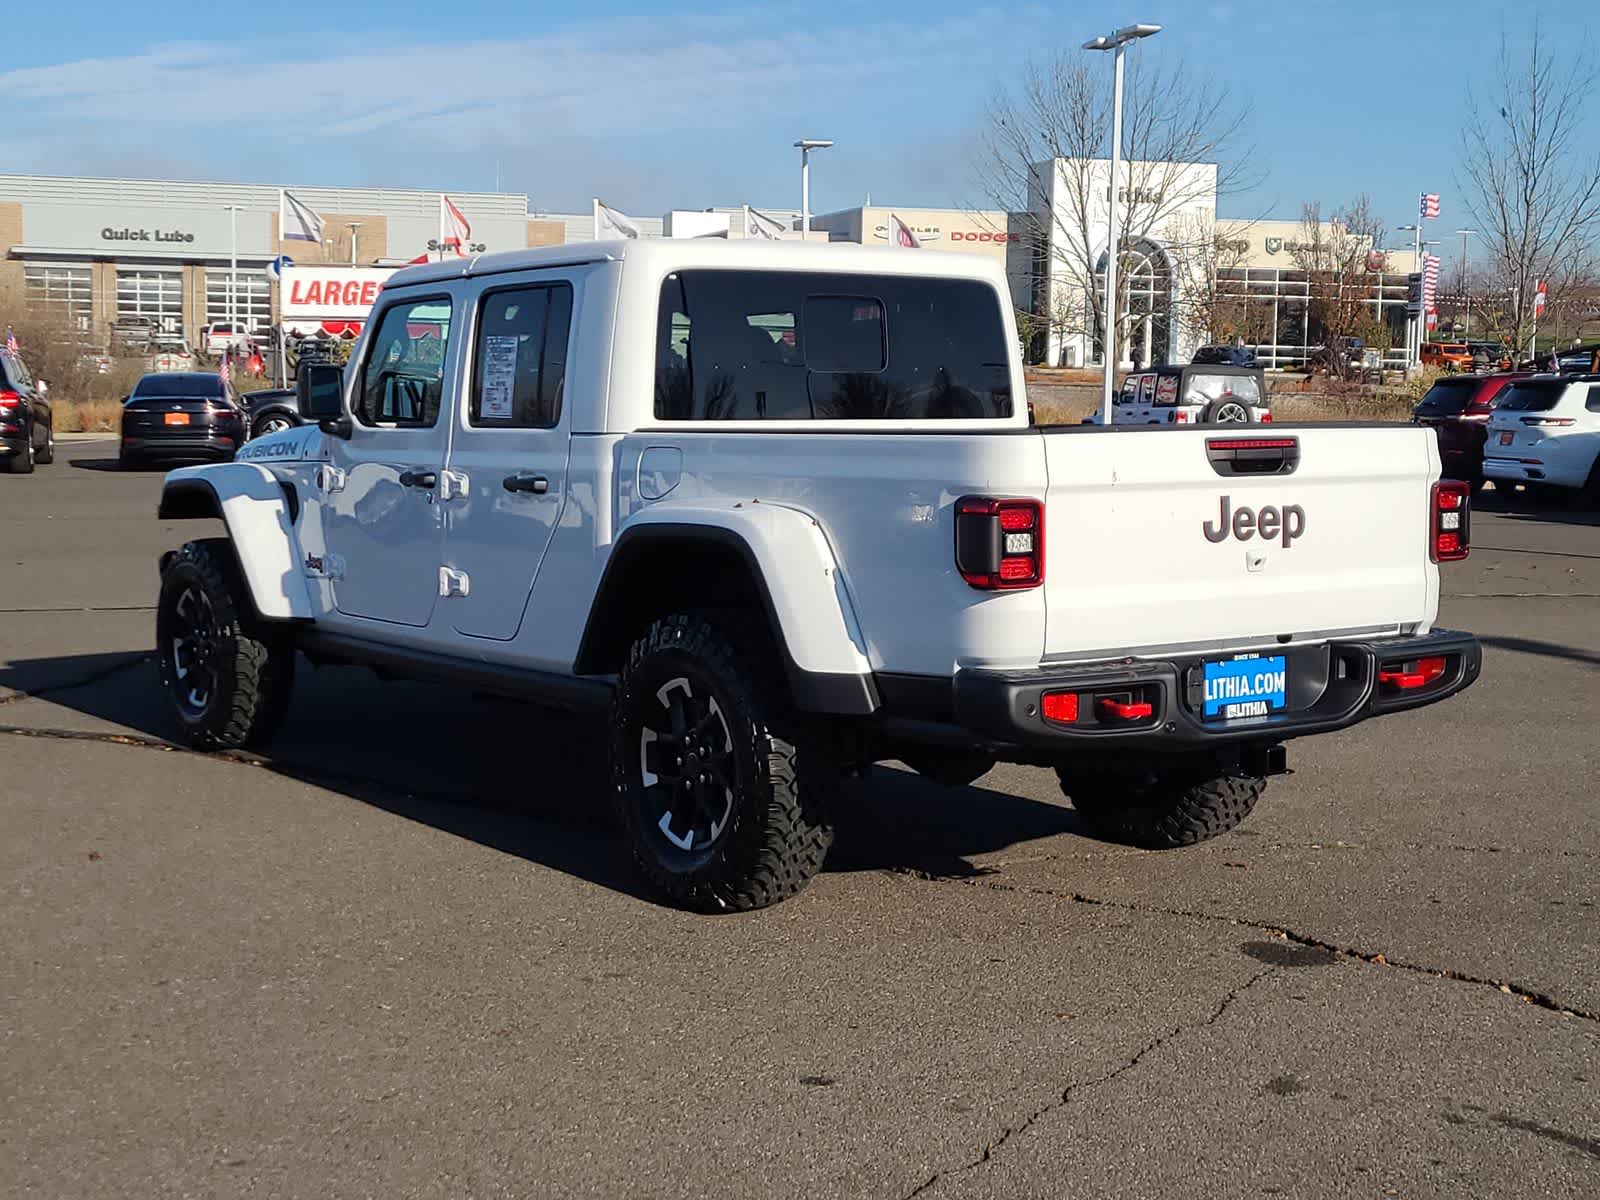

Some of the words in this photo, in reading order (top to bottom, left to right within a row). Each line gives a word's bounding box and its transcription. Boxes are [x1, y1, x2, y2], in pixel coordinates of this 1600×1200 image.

[101, 227, 150, 241] Quick
[155, 229, 194, 242] Lube
[1202, 495, 1306, 549] Jeep
[1204, 671, 1286, 702] LITHIA.COM
